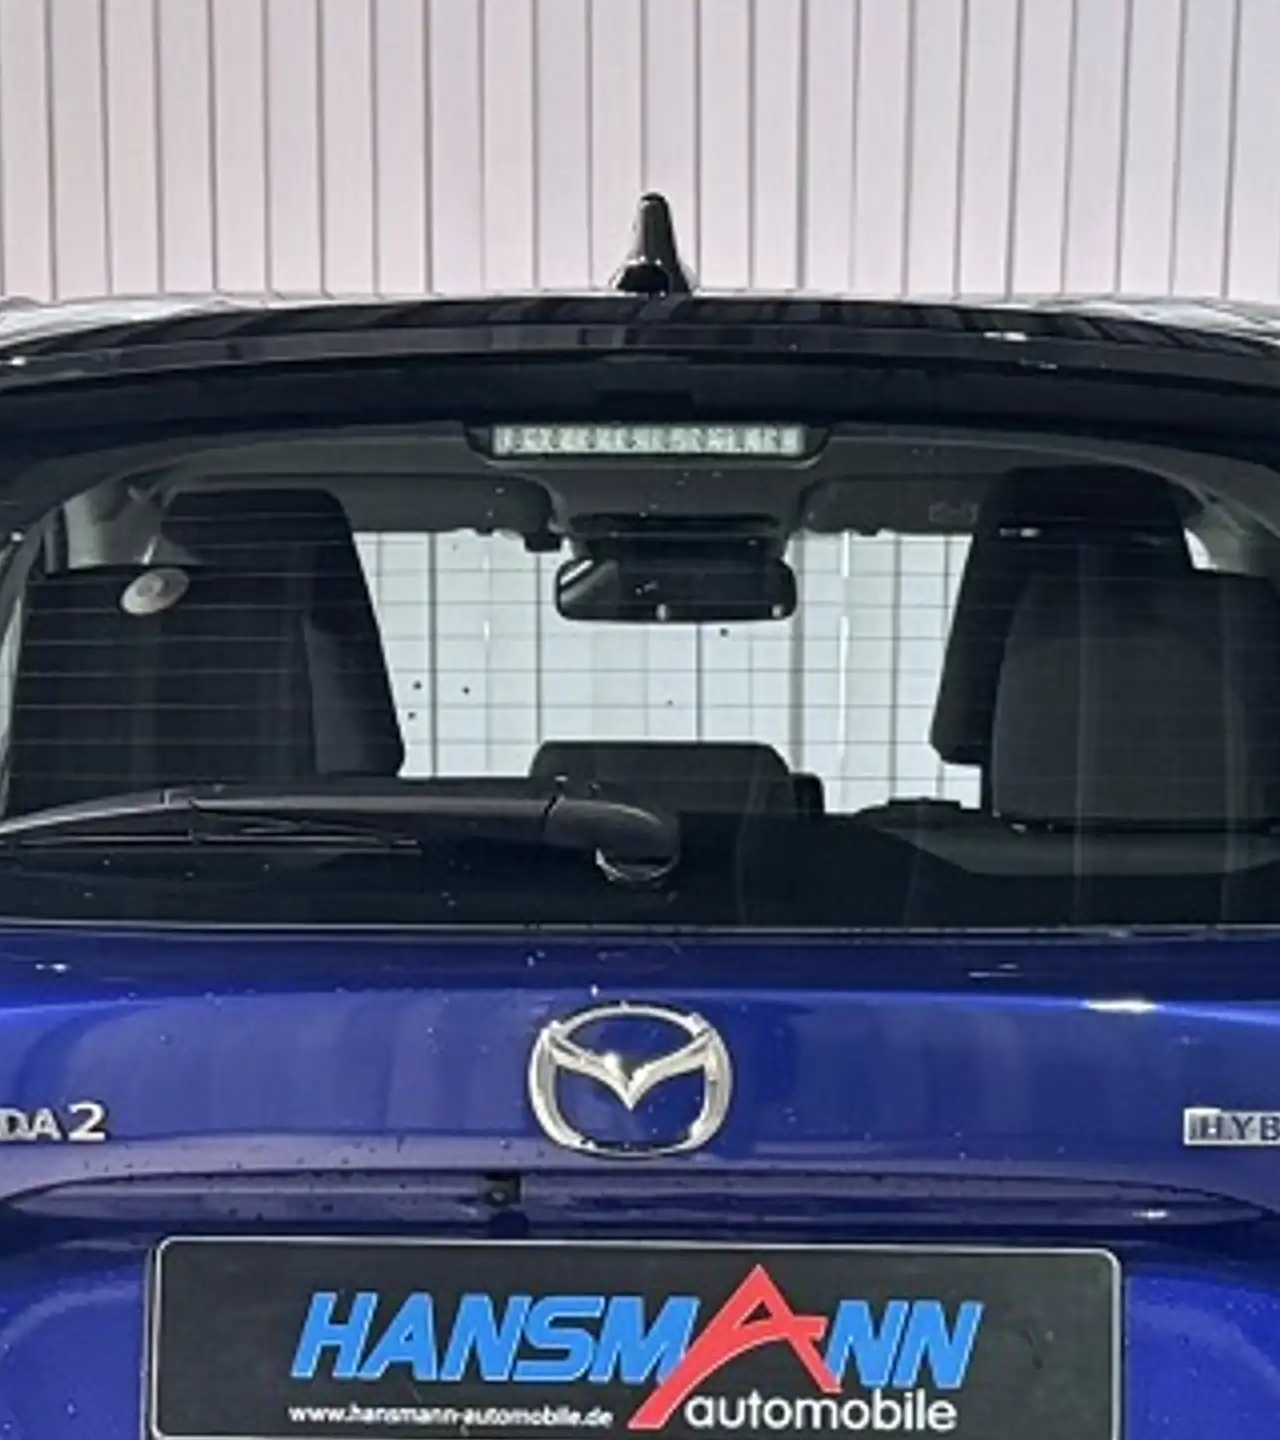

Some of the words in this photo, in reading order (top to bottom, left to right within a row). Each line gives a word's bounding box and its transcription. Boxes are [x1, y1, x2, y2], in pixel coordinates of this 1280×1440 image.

[290, 1263, 984, 1431] HANSMANN
[288, 1402, 615, 1429] www.hansmann-automobile.de
[684, 1386, 958, 1431] automobile
